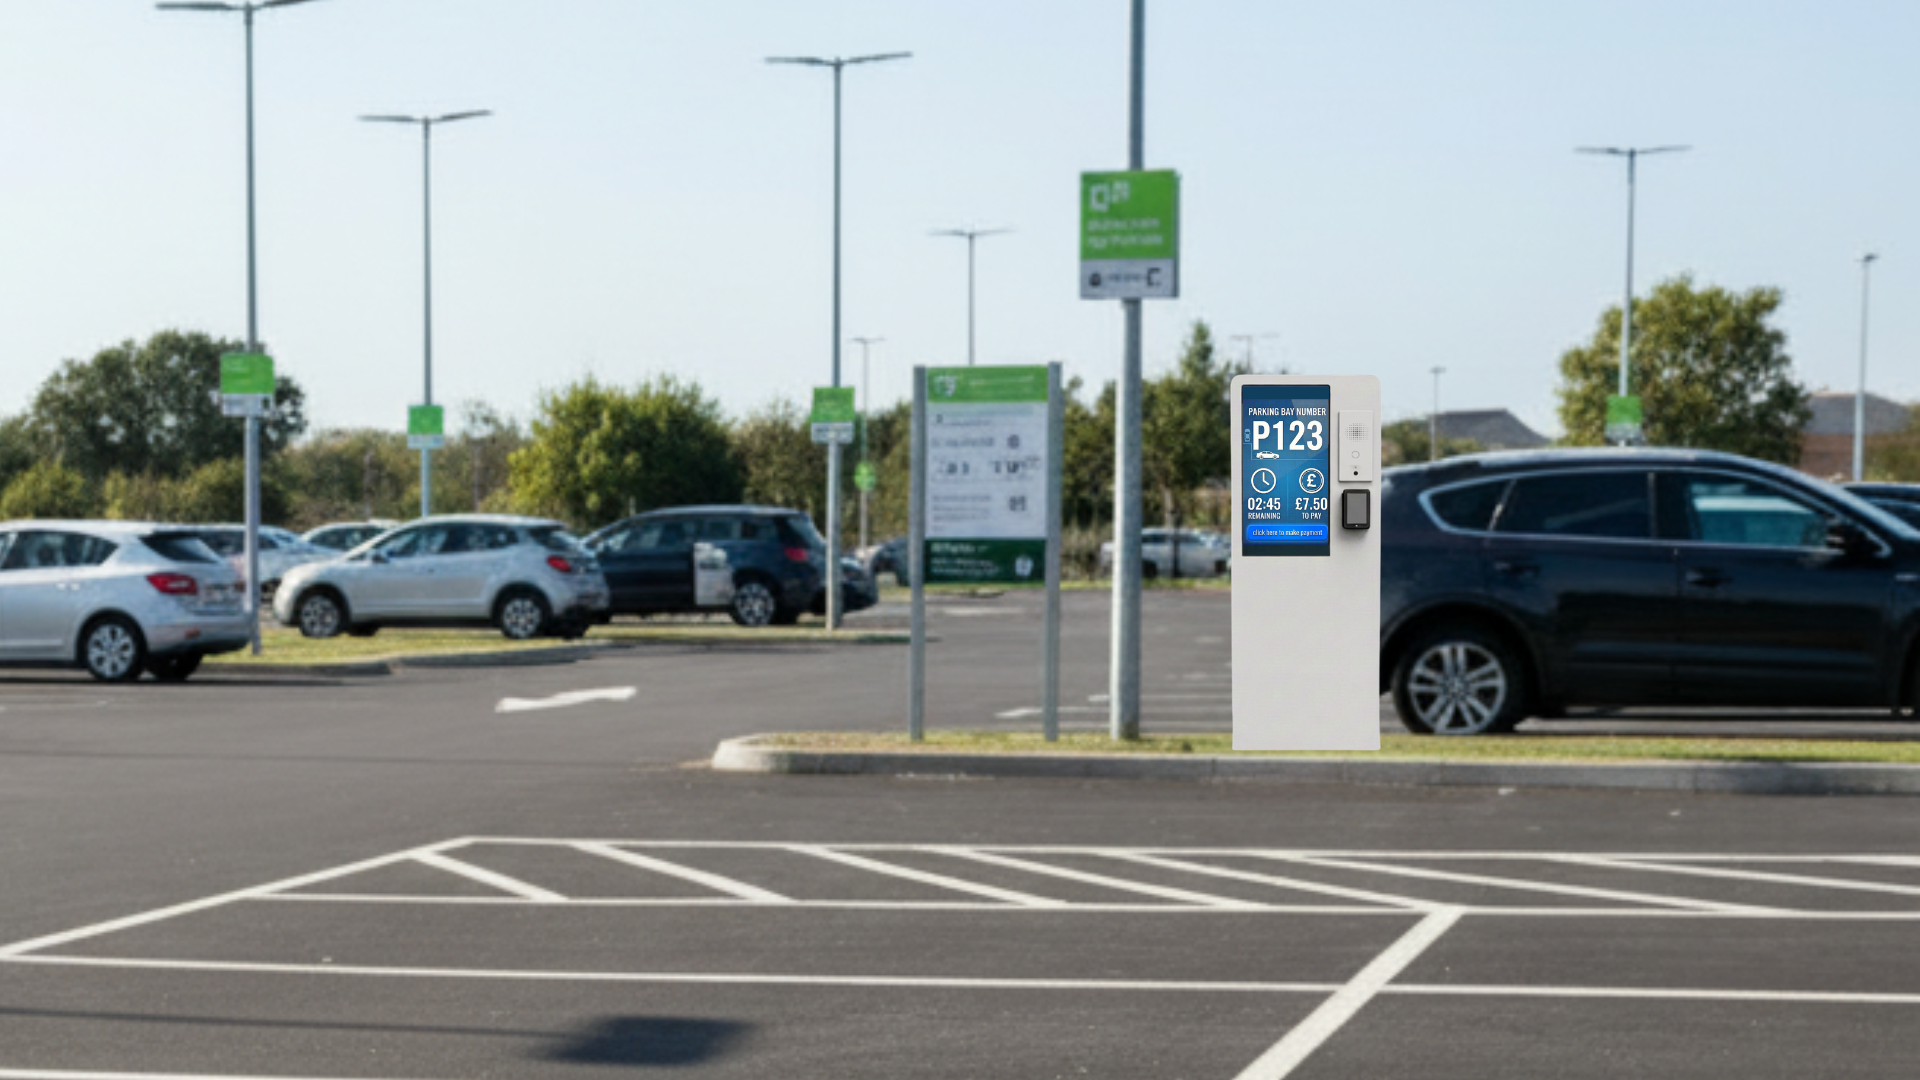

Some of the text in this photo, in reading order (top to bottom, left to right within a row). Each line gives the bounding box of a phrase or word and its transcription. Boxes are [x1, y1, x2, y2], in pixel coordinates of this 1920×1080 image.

[1248, 407, 1327, 416] PARKING BAY NUMBER
[1253, 420, 1323, 451] P123
[1247, 497, 1281, 511] 02:45
[1295, 497, 1328, 511] £7.50
[1247, 512, 1281, 520] REMAINING
[1302, 512, 1322, 520] TO PAY
[1300, 529, 1323, 538] payment
